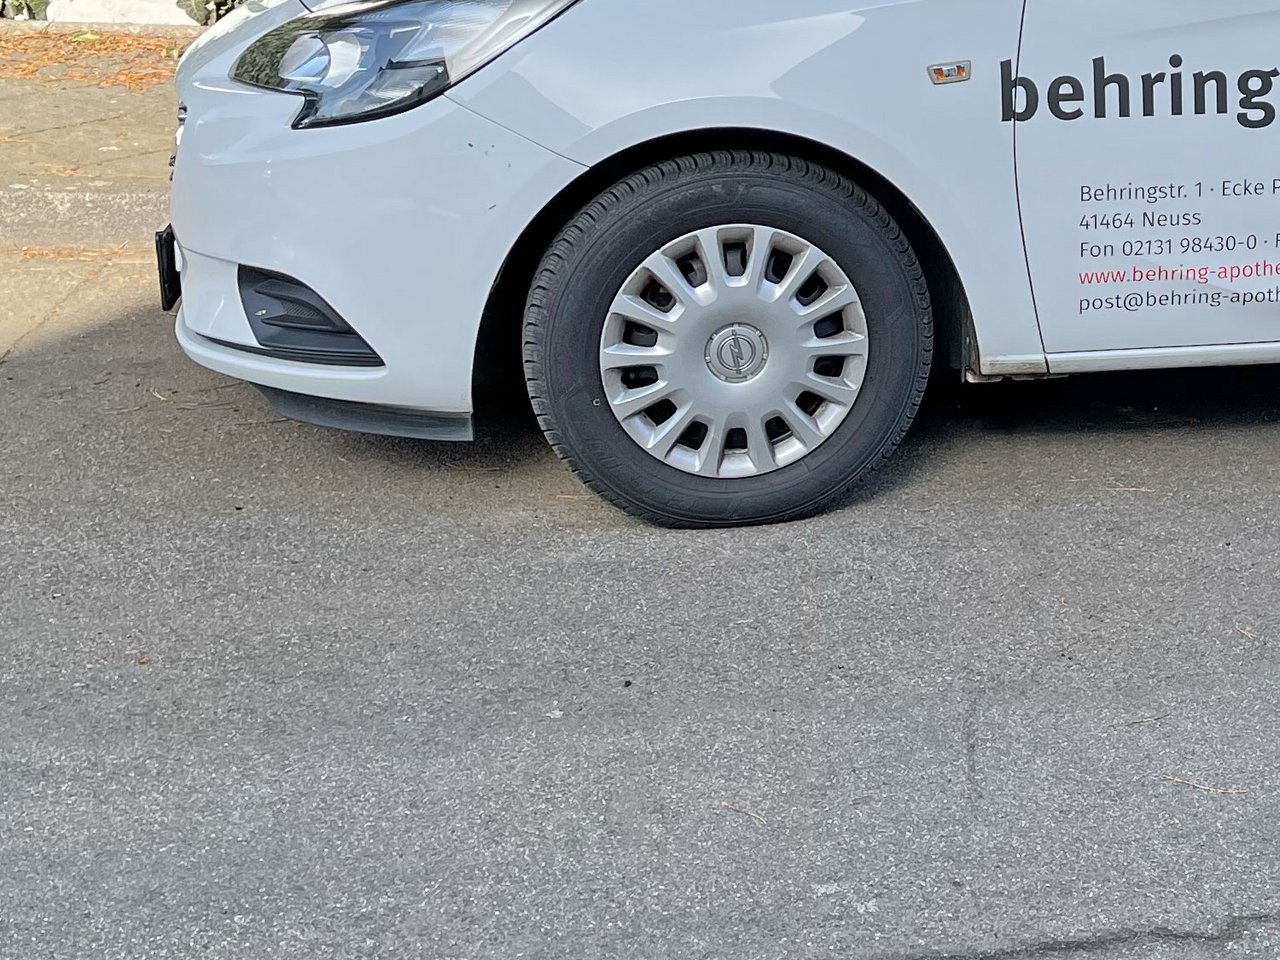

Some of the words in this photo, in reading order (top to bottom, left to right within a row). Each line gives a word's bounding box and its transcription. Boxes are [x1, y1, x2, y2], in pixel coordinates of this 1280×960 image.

[1080, 182, 1188, 204] Behringstr.
[1194, 182, 1203, 198] 1
[1221, 179, 1265, 197] Ecke
[1079, 212, 1135, 230] 41464
[1142, 211, 1202, 228] Neuss
[1080, 241, 1114, 258] Fon
[1122, 239, 1173, 257] 02131
[1180, 234, 1257, 254] 98430-0
